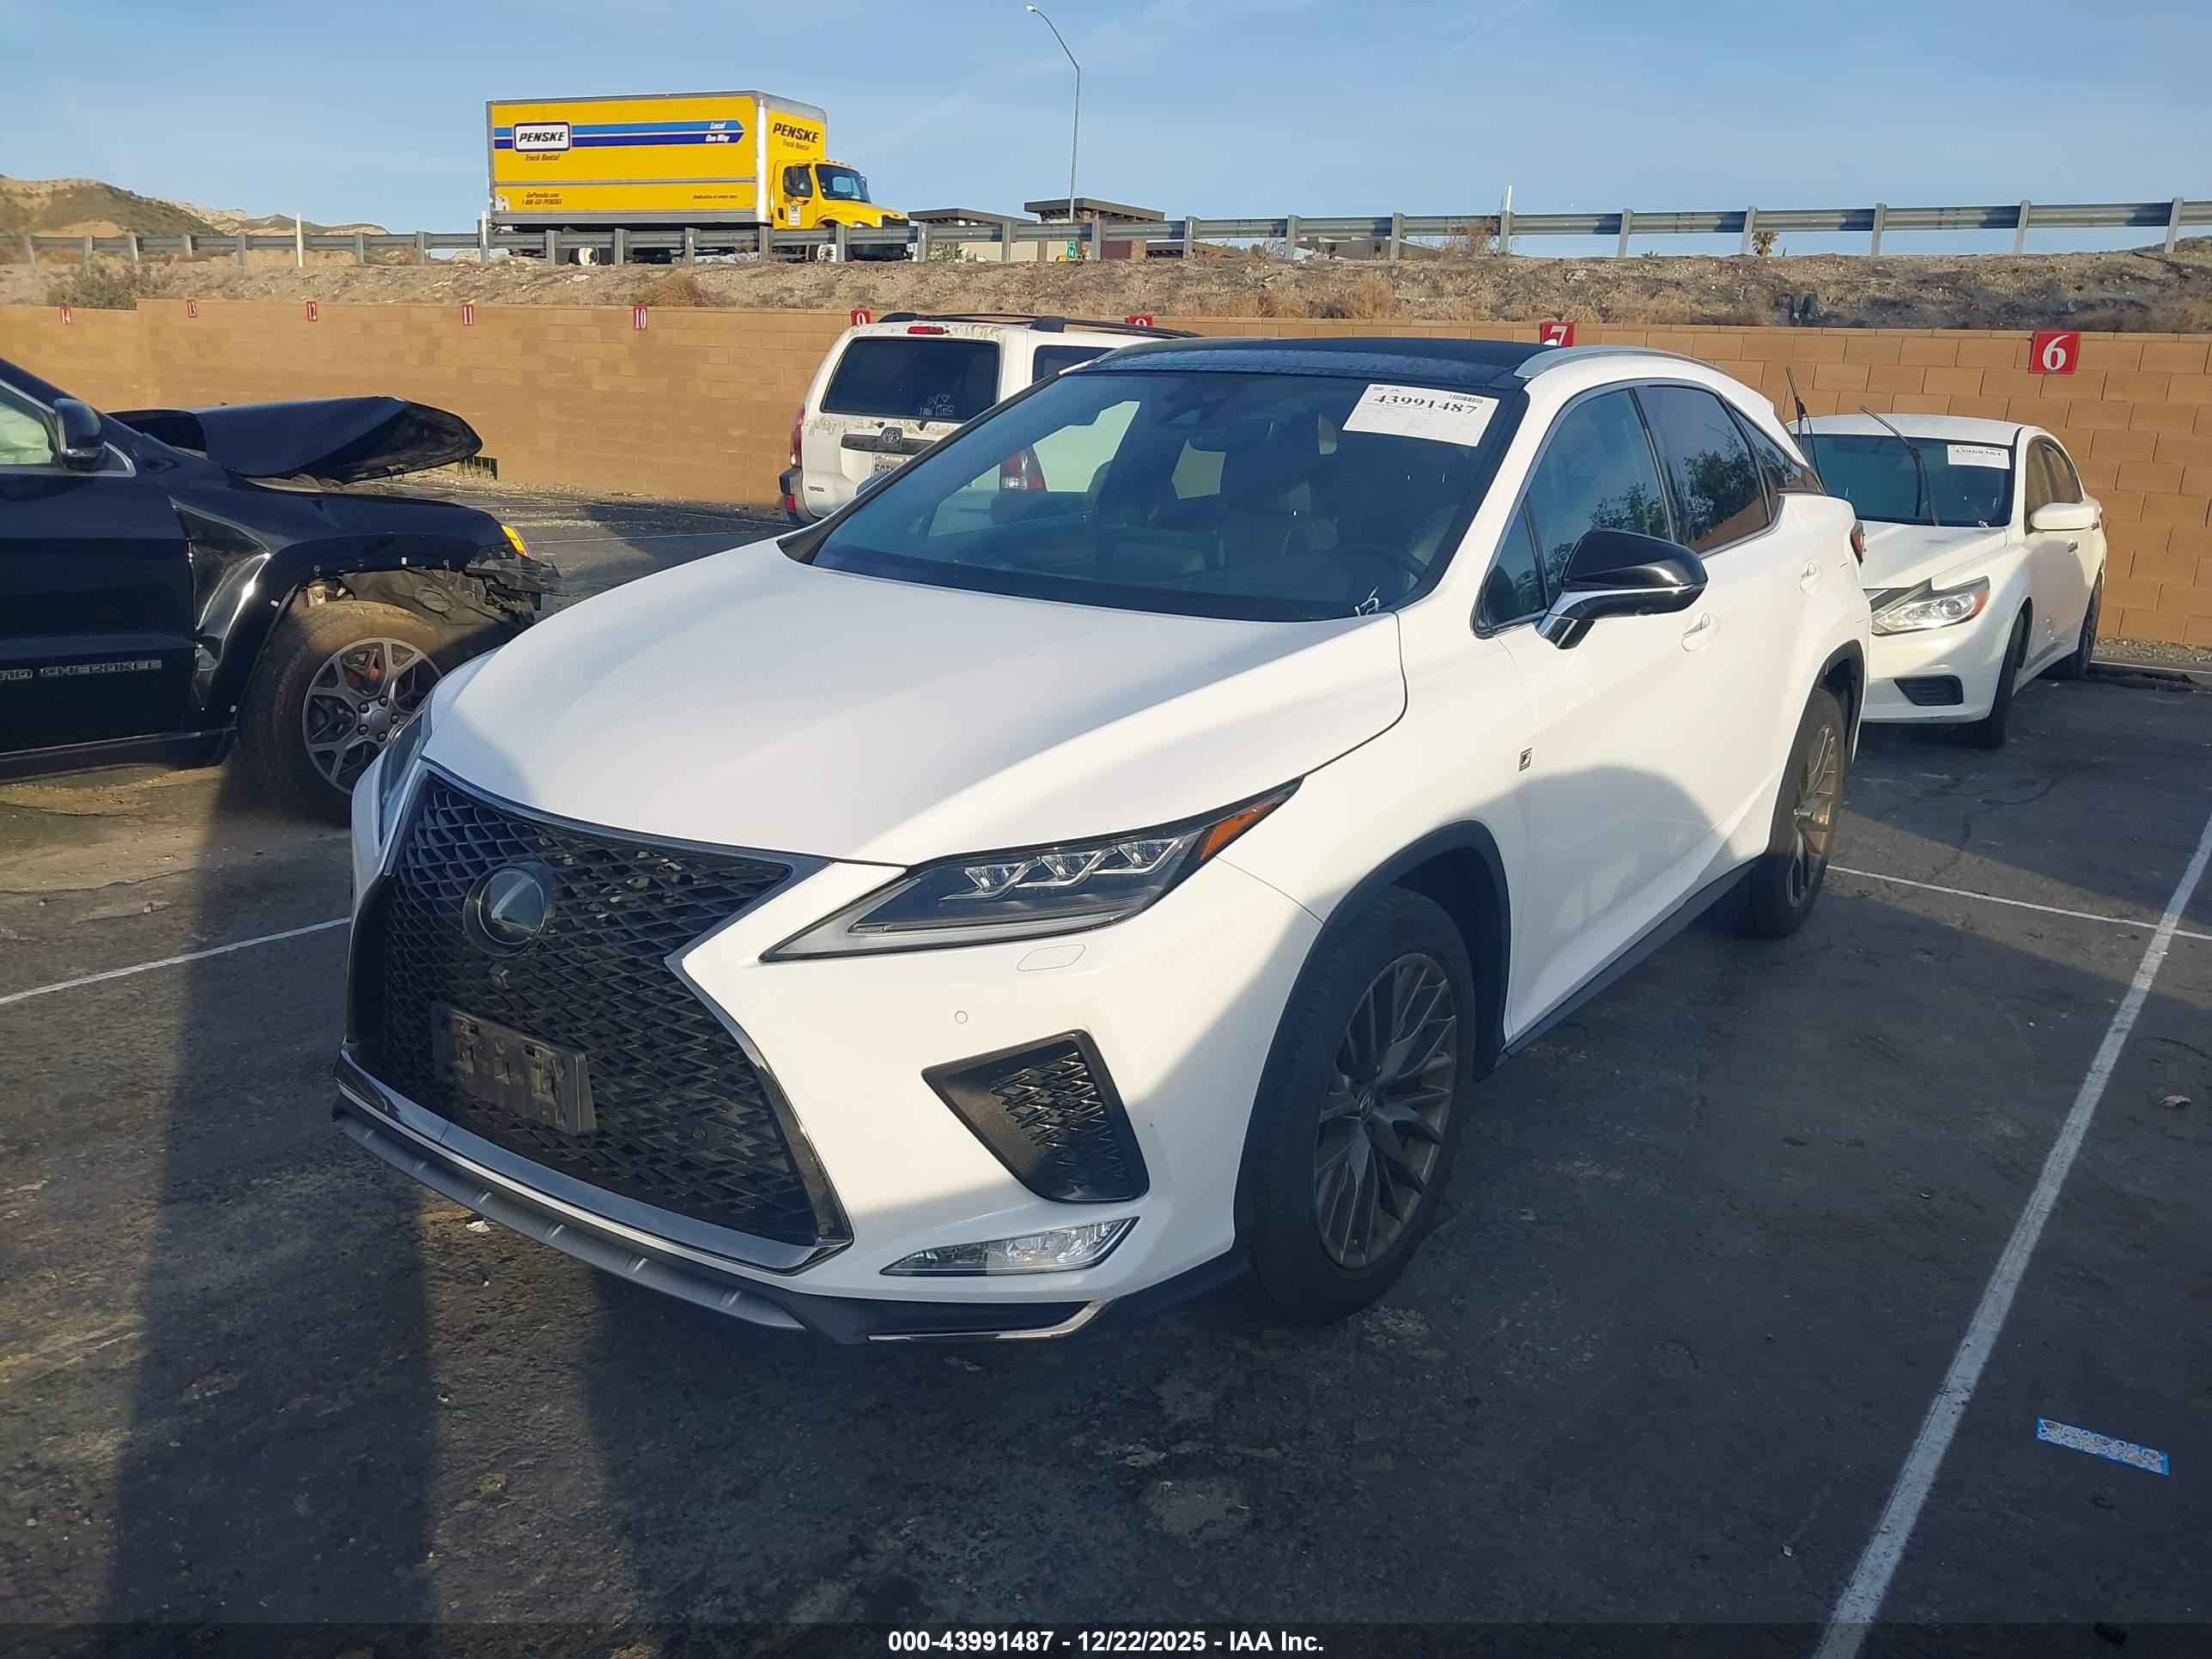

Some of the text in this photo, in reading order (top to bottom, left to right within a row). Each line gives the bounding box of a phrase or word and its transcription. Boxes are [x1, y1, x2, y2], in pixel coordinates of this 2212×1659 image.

[518, 131, 566, 143] PENSKE
[772, 122, 820, 144] PENSKE
[61, 309, 70, 324] 14
[187, 301, 197, 317] 13
[307, 302, 317, 320] 12
[464, 306, 473, 325] 11
[635, 308, 647, 329] 10
[1549, 325, 1568, 346] 7
[2042, 334, 2070, 370] 6
[1374, 394, 1478, 415] 43991487
[40, 659, 162, 677] CHEROKEE
